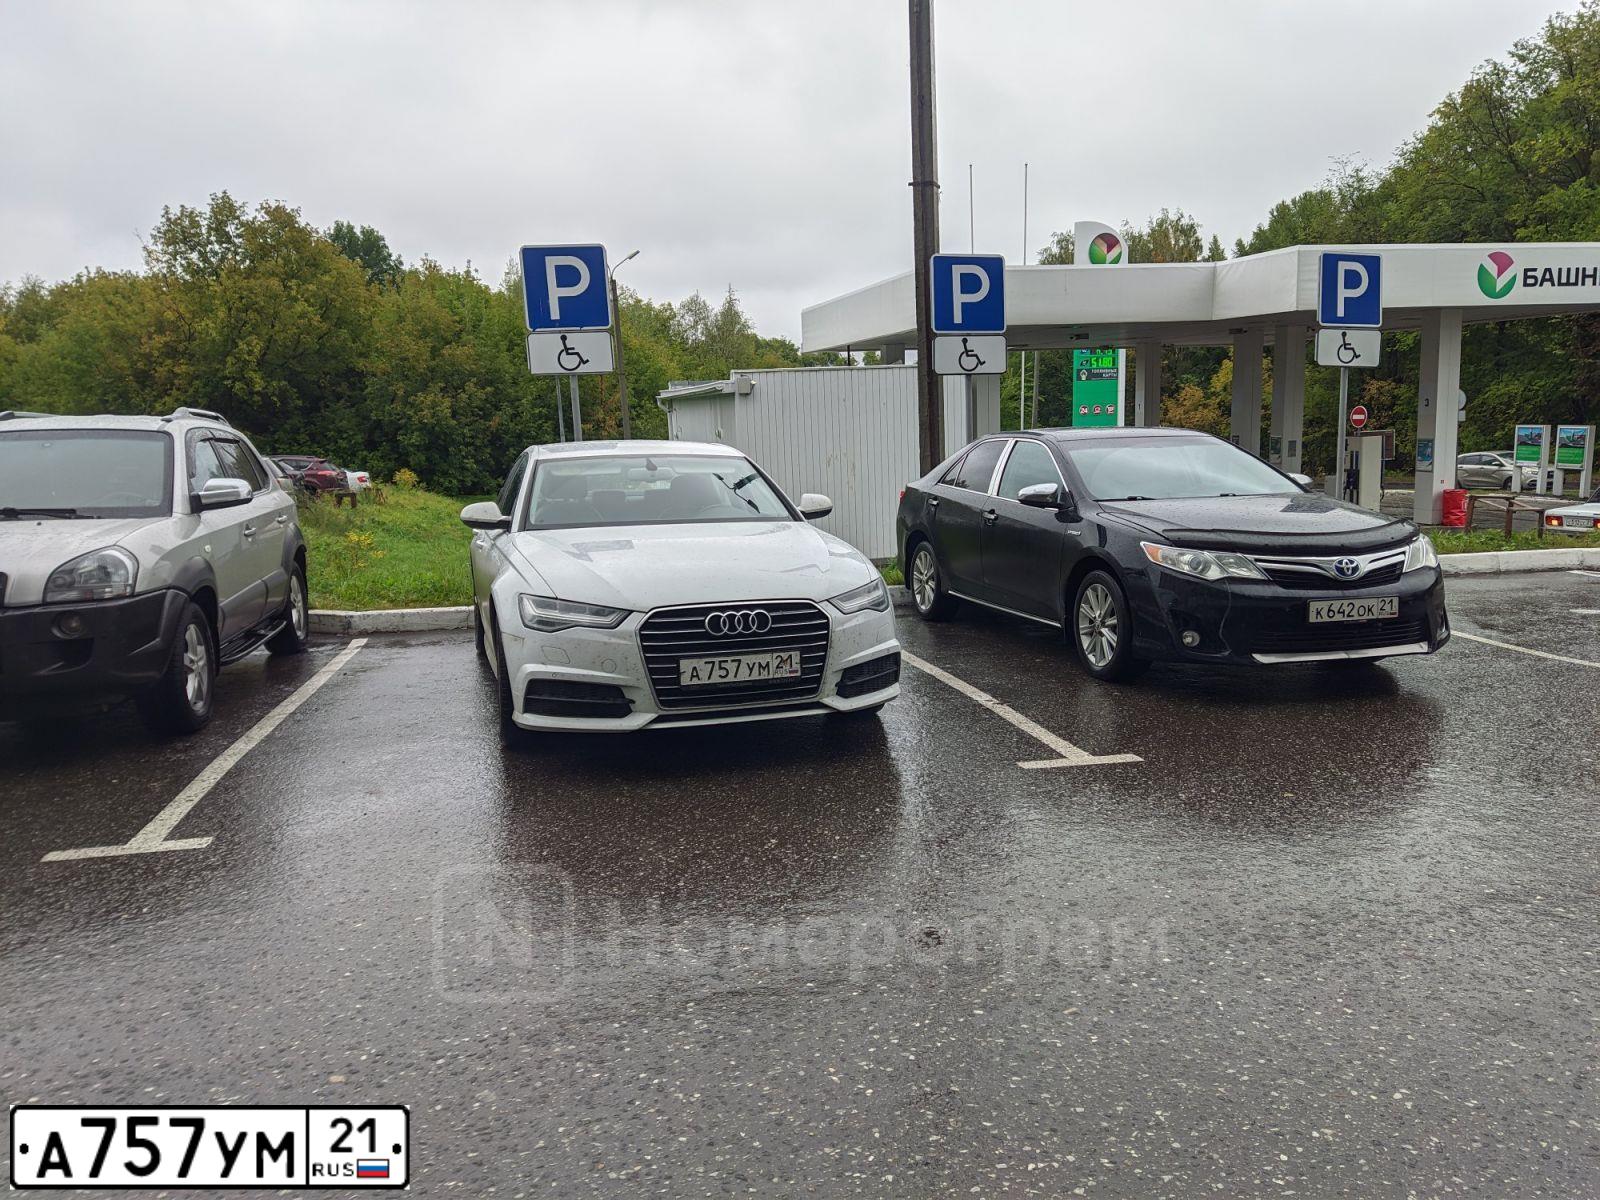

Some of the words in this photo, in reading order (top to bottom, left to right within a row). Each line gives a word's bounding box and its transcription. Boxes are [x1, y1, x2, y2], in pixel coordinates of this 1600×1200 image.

[545, 256, 591, 321] P
[952, 264, 990, 324] P
[1336, 261, 1368, 318] P
[1522, 267, 1600, 287] БАШН
[1315, 602, 1375, 620] К642ОК
[1379, 599, 1394, 612] 21
[689, 659, 771, 682] А757УМ
[775, 654, 793, 670] 21
